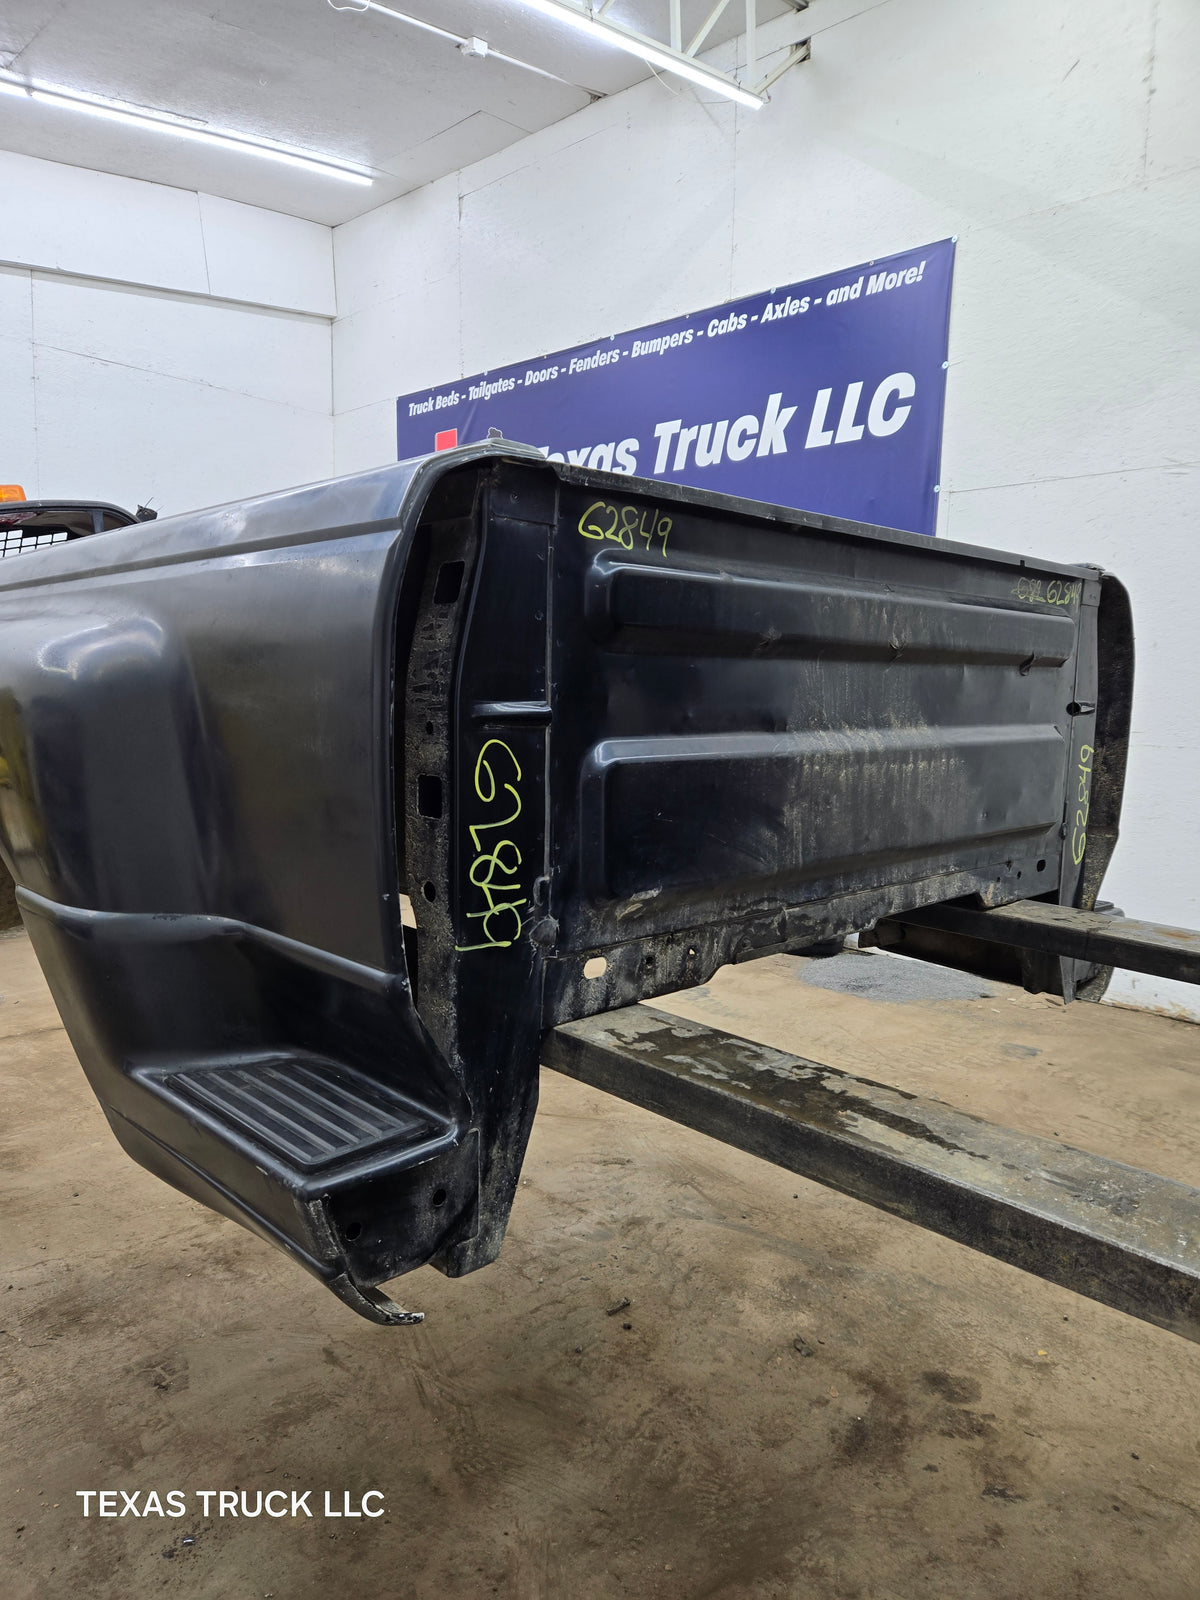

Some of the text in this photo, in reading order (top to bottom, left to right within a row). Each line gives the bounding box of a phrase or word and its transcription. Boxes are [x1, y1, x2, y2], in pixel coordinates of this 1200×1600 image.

[408, 397, 435, 416] Truck
[435, 390, 459, 410] Beds
[469, 376, 515, 401] Tailgates
[525, 367, 558, 386] Doors
[568, 349, 620, 375] Fenders
[631, 328, 694, 359] Bumpers
[707, 312, 748, 338] Cabs
[760, 296, 810, 324] Axles
[826, 276, 864, 307] and
[865, 260, 927, 297] More!
[653, 391, 799, 475] Truck
[804, 371, 916, 450] LLC
